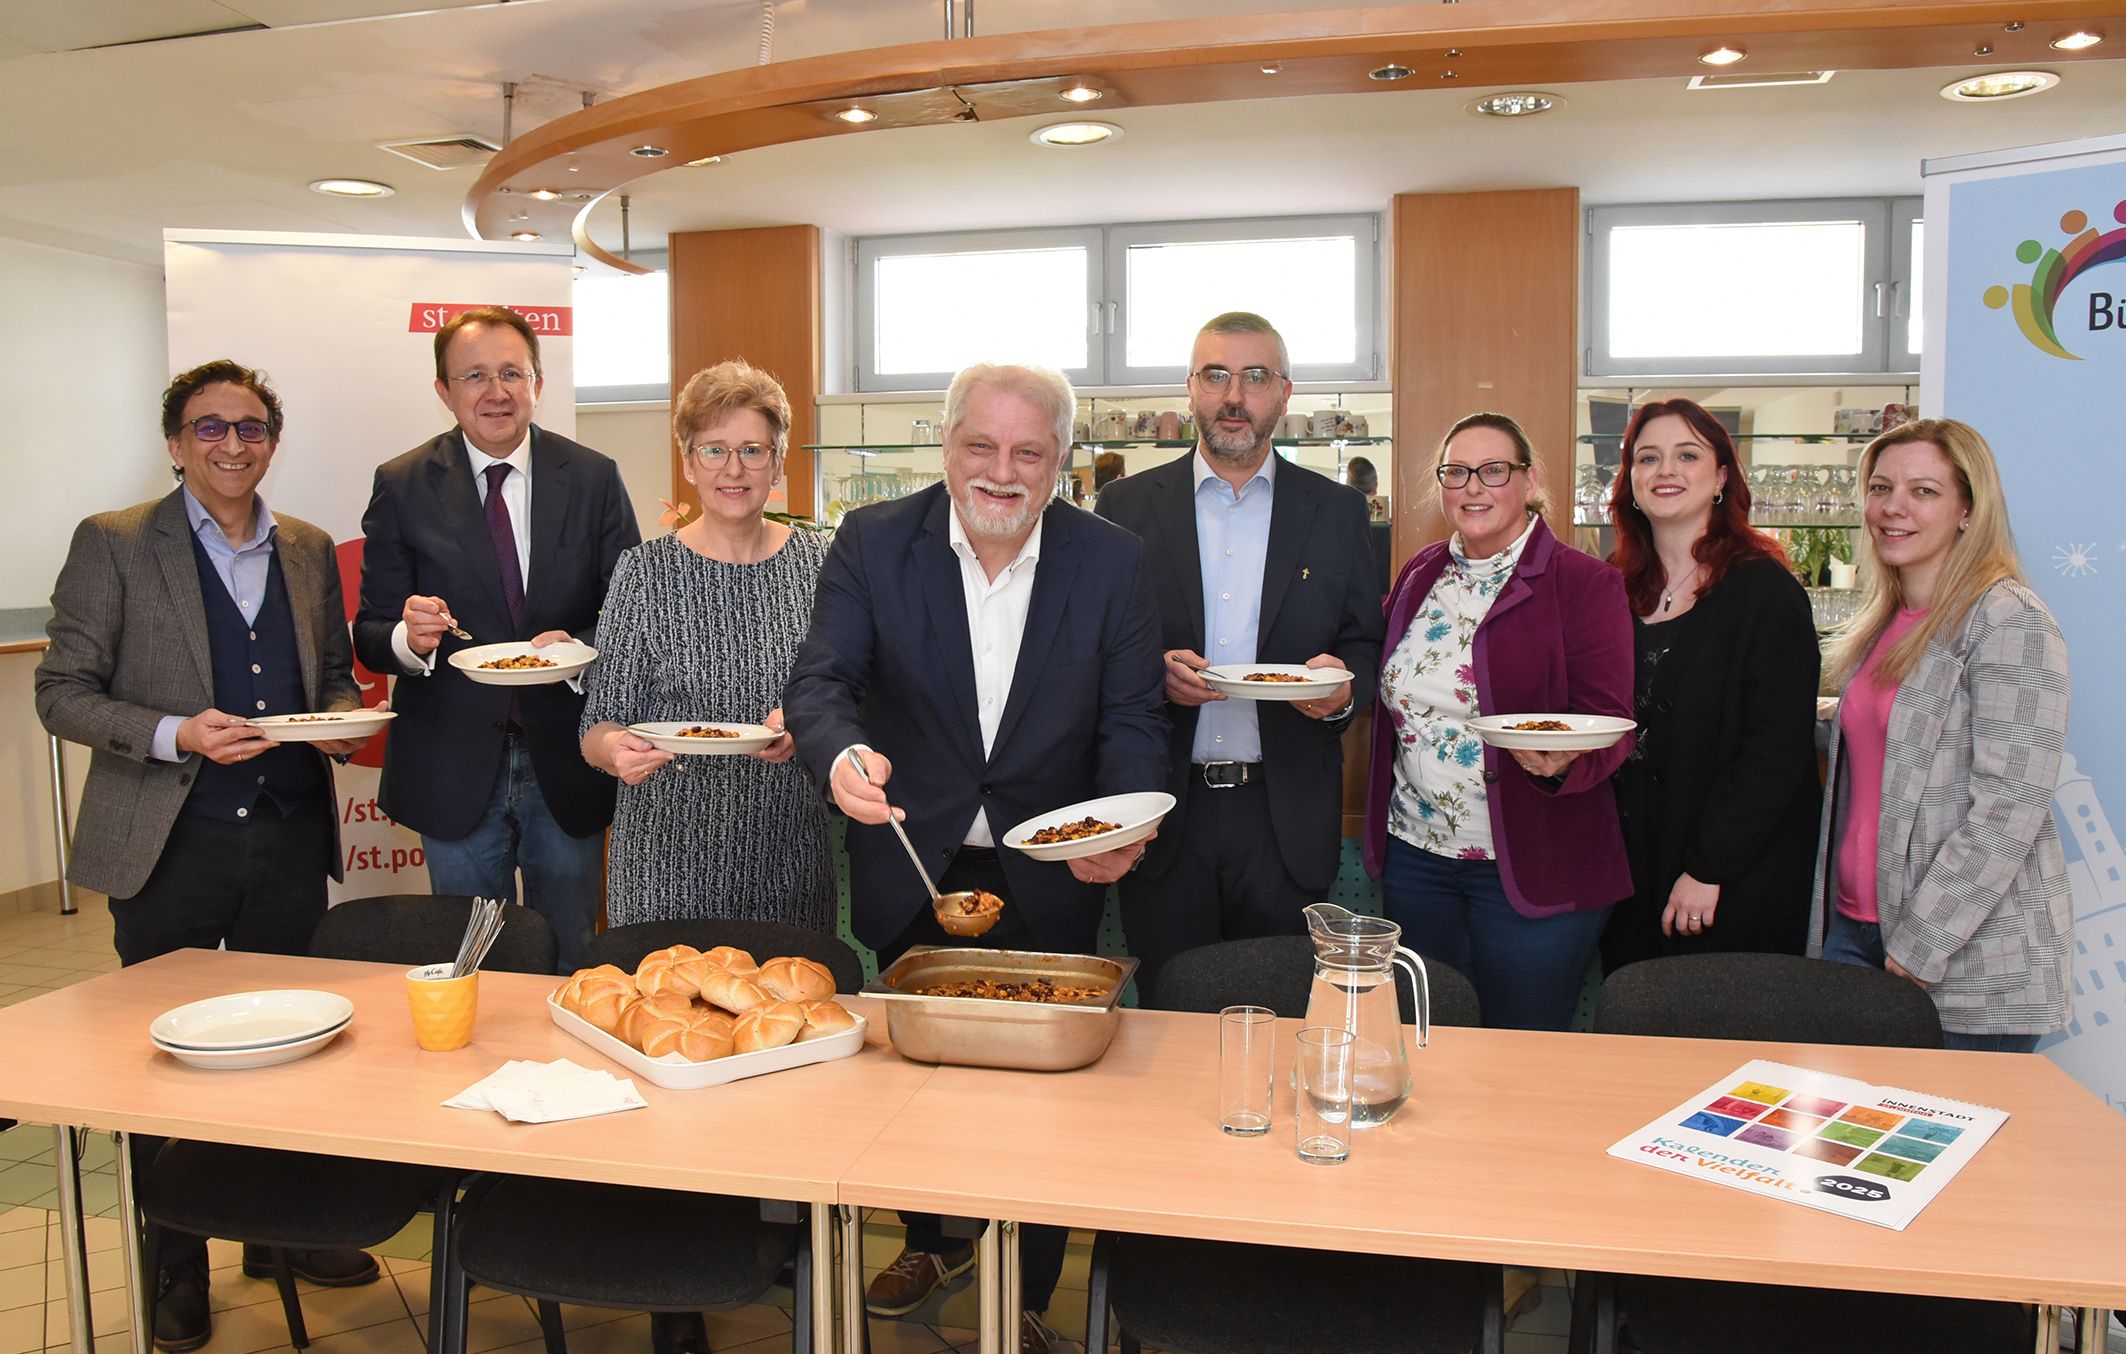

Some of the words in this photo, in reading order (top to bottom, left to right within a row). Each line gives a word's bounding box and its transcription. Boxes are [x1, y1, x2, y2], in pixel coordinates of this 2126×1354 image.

[1881, 1098, 1976, 1122] INNENSTADT
[1639, 1144, 1689, 1163] der
[1696, 1157, 1798, 1190] Vielfalt
[1652, 1137, 1781, 1176] Kalender
[1820, 1178, 1884, 1199] 2025
